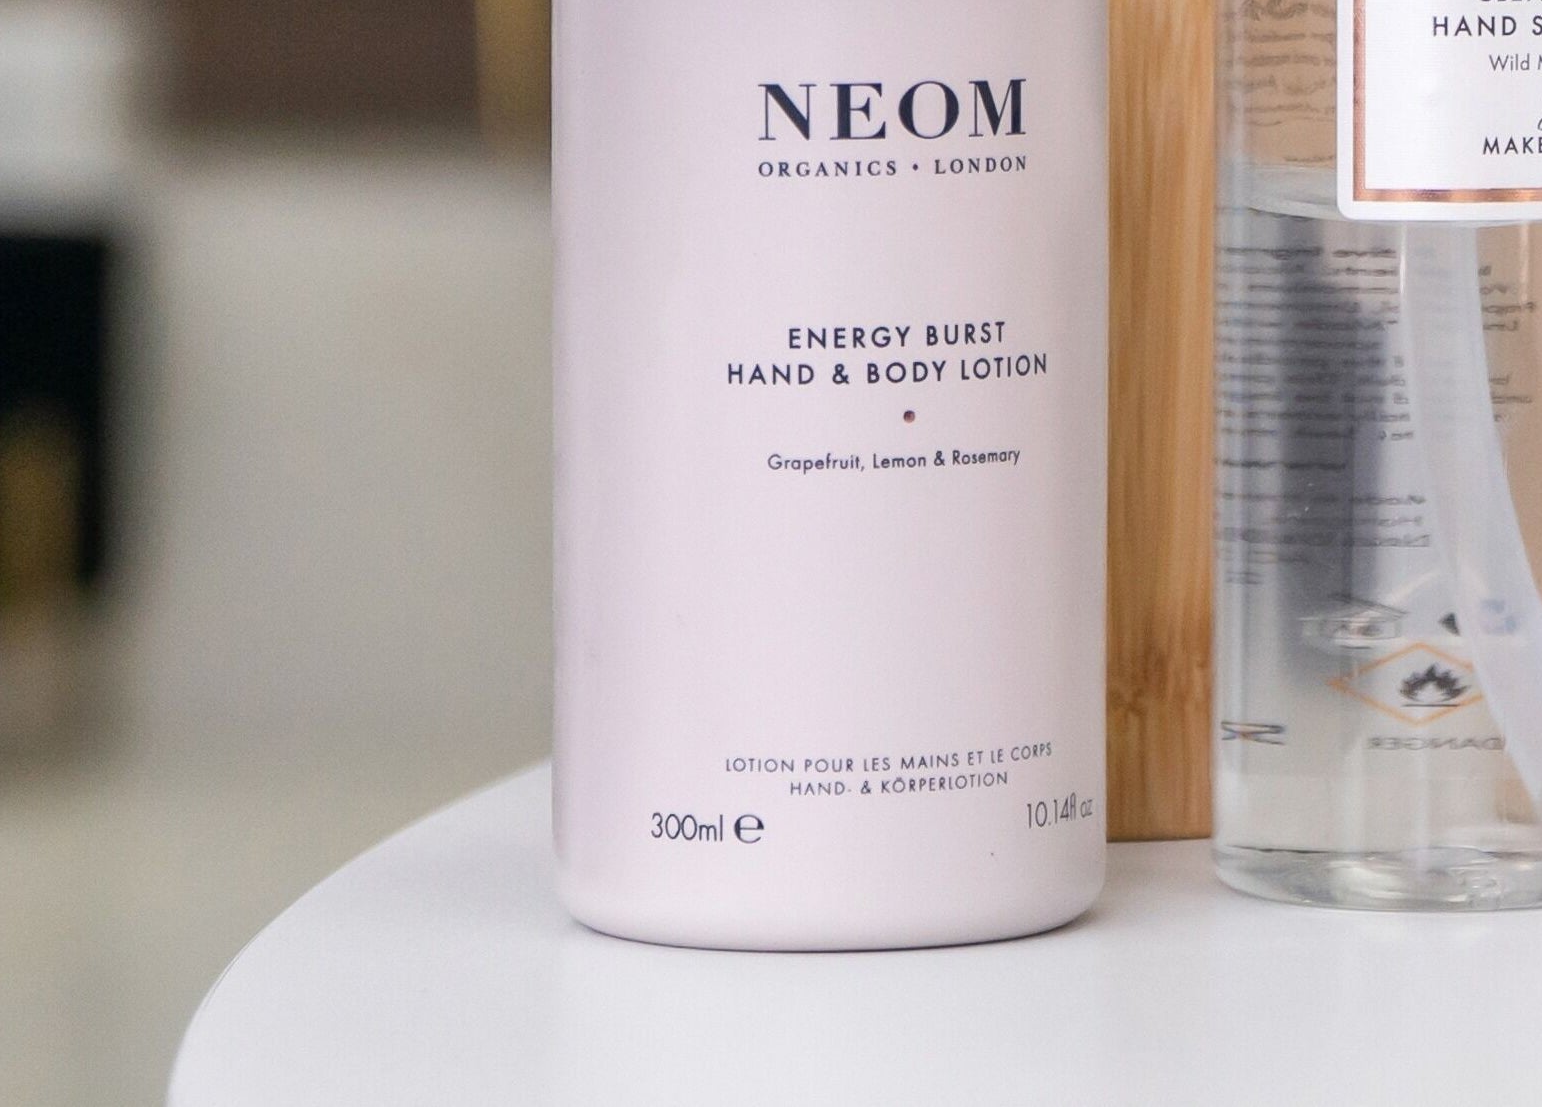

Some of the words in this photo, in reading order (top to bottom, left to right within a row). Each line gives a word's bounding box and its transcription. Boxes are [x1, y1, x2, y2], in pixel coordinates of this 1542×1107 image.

[1433, 16, 1516, 36] HAND
[1489, 53, 1530, 71] Wild
[758, 79, 1026, 140] NEOM
[758, 161, 896, 177] ORGANICS
[935, 156, 1025, 174] LONDON
[789, 326, 910, 349] ENERGY
[926, 321, 1005, 346] BURST
[728, 363, 814, 385] HAND
[832, 364, 849, 385] &
[867, 360, 946, 384] BODY
[961, 353, 1046, 380] LOTION
[768, 453, 864, 475] Grapefruit,
[873, 453, 926, 469] Lemon
[934, 451, 945, 466] &
[952, 450, 1020, 465] Rosemary
[726, 758, 794, 773] LOTION
[805, 758, 853, 773] POUR
[864, 757, 890, 772] LES
[901, 753, 959, 770] MAINS
[968, 751, 983, 766] ET
[991, 749, 1003, 764] LE
[1011, 742, 1052, 761] CORPS
[790, 781, 851, 795] HAND-
[860, 780, 871, 794] &
[881, 771, 1008, 793] KÖRPERLOTION
[1027, 792, 1076, 829] 10.14fl
[1080, 799, 1093, 818] oz
[651, 812, 723, 842] 300ml
